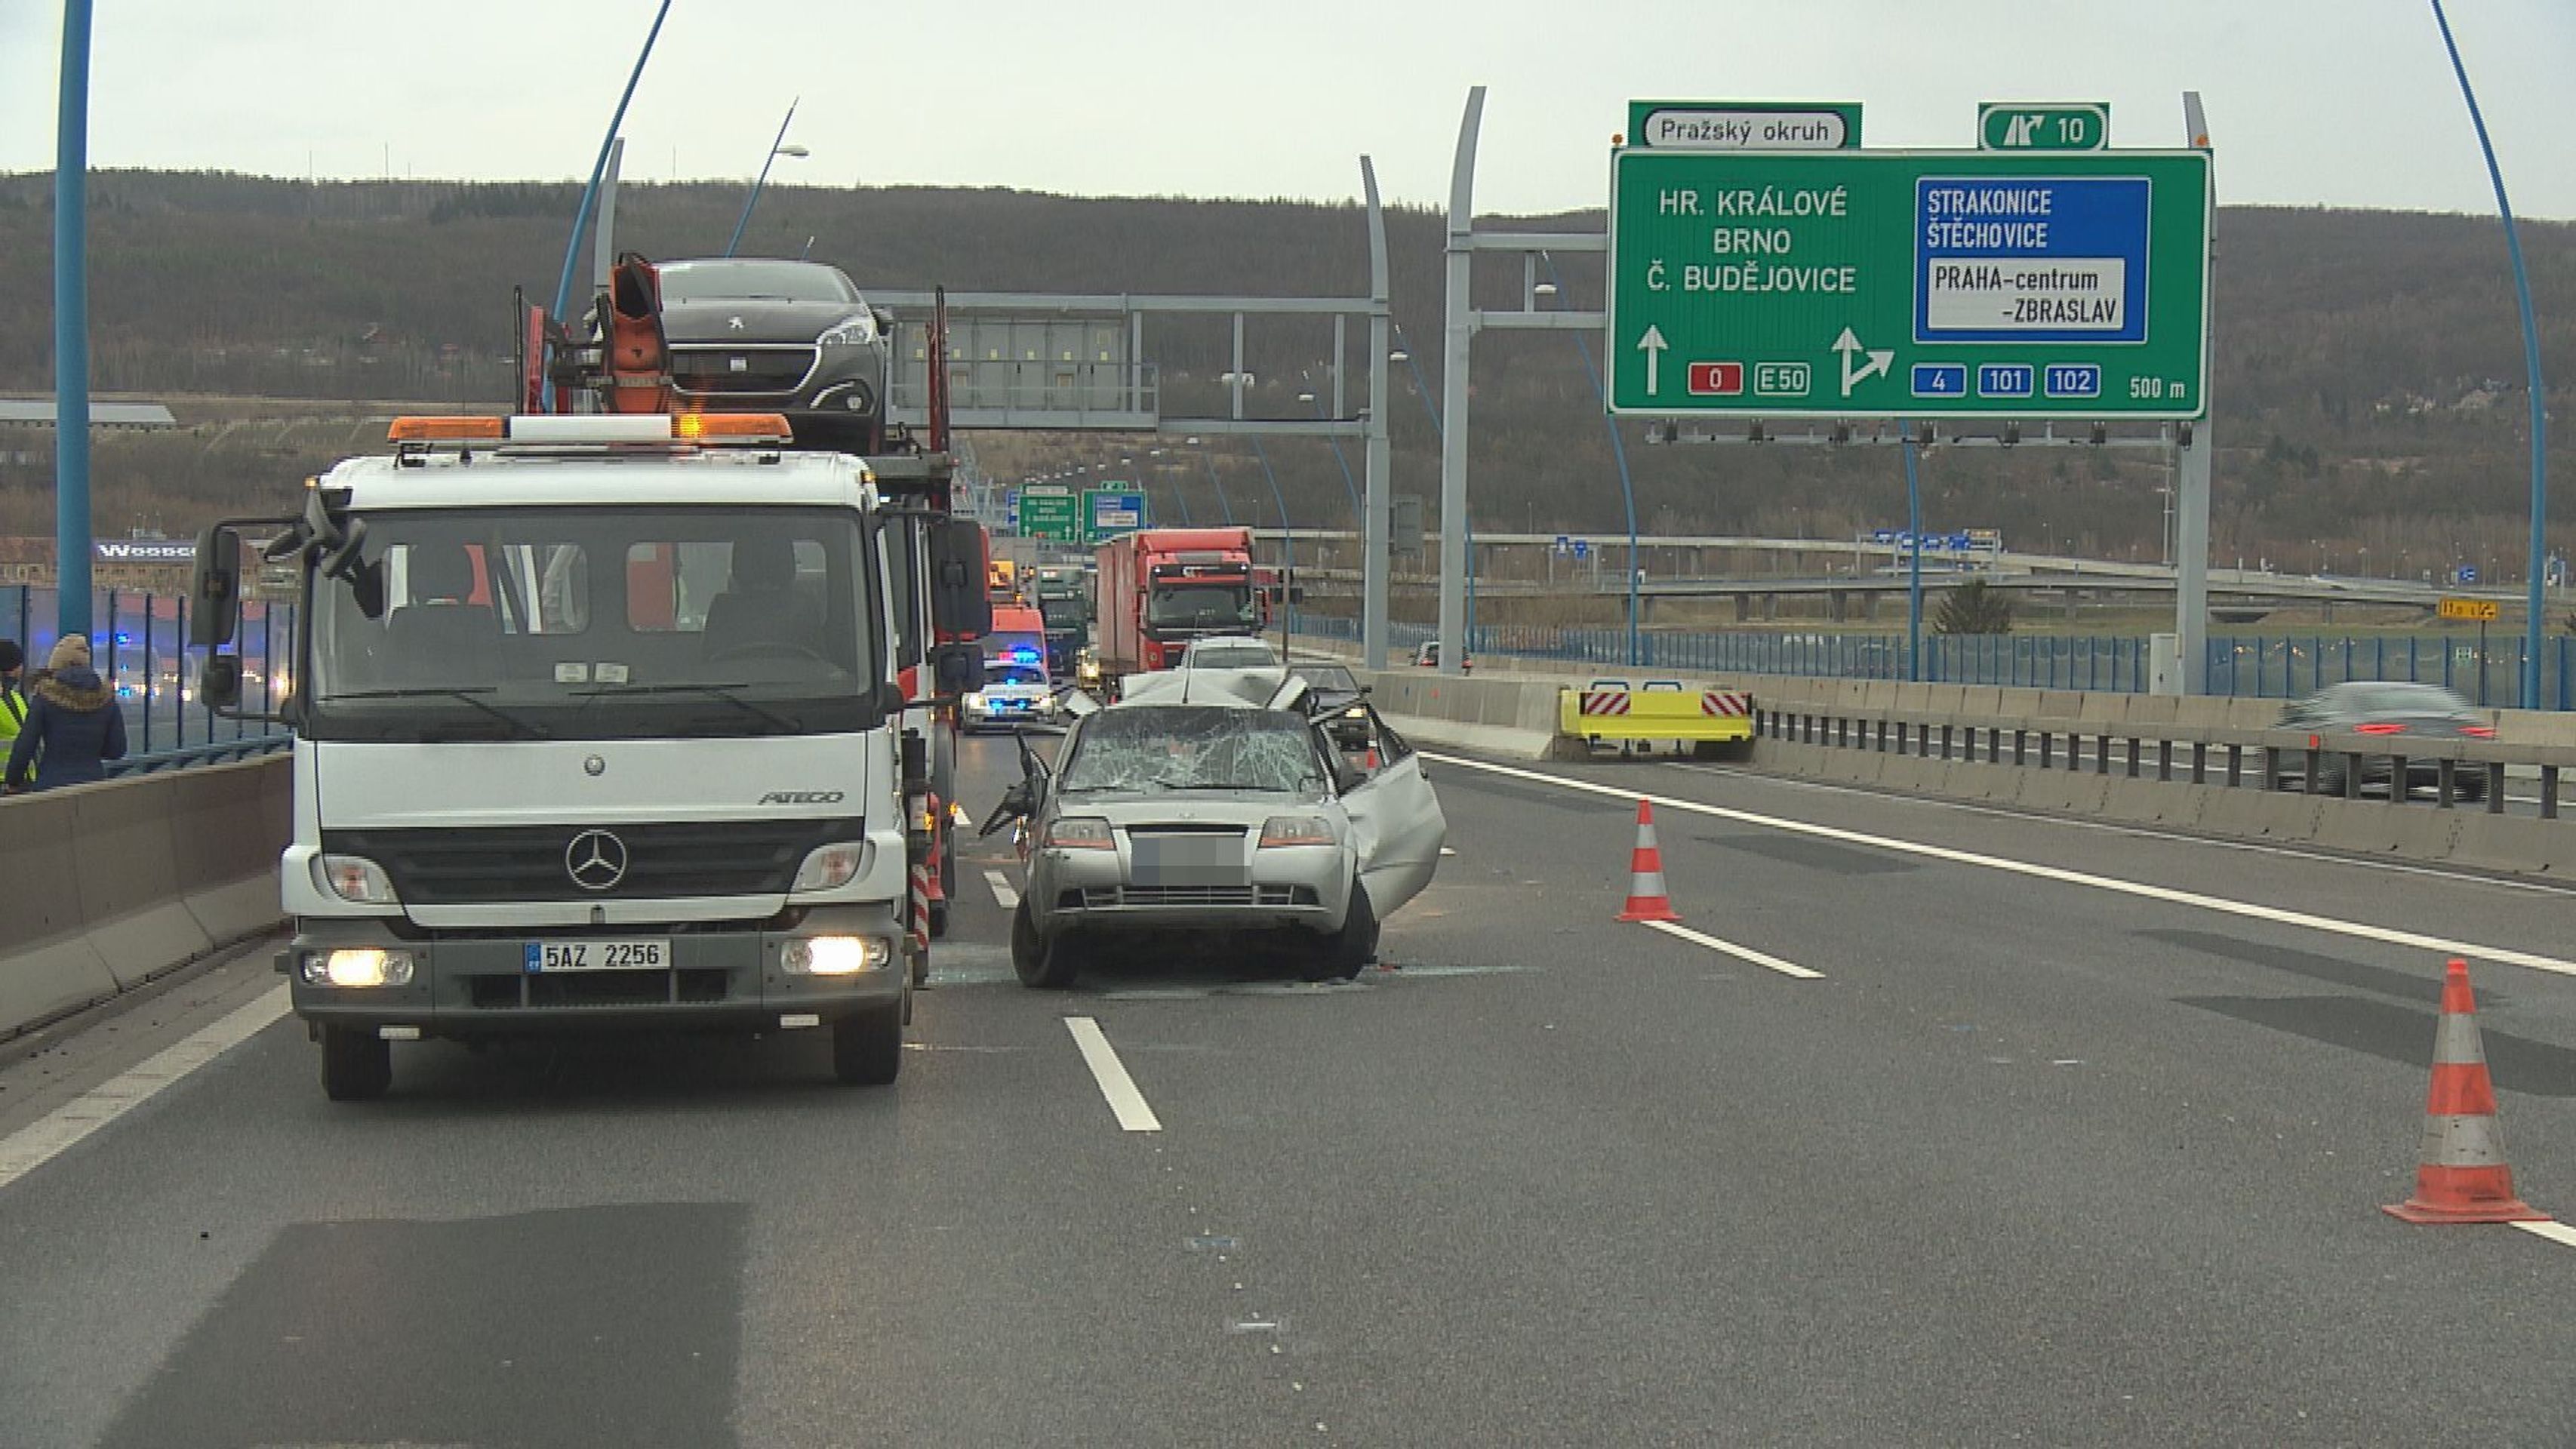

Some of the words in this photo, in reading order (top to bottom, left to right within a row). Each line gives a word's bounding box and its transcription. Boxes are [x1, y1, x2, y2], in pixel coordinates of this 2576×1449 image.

[1661, 120, 1751, 146] Pražský
[1764, 121, 1828, 140] okruh
[2057, 118, 2084, 143] 10
[1660, 189, 1704, 216] HR.
[1718, 186, 1847, 216] KRÁLOVÉ
[1928, 190, 2051, 215] STRAKONICE
[1714, 228, 1791, 254] BRNO
[1928, 216, 2048, 248] ŠTĚCHOVICE
[1648, 258, 1670, 291] Č.
[1684, 260, 1856, 291] BUDĚJOVICE
[1935, 266, 2098, 290] PRAHA-centrum
[2002, 298, 2116, 323] -ZBRASLAV
[1710, 368, 1722, 389] 0
[1931, 371, 1945, 390] 4
[1990, 371, 2020, 391] 101
[2054, 371, 2090, 391] 102
[2130, 377, 2162, 398] 500
[2169, 381, 2184, 398] m
[757, 792, 844, 805] ATEGO
[546, 947, 587, 967] 5AZ
[605, 945, 658, 966] 2256
